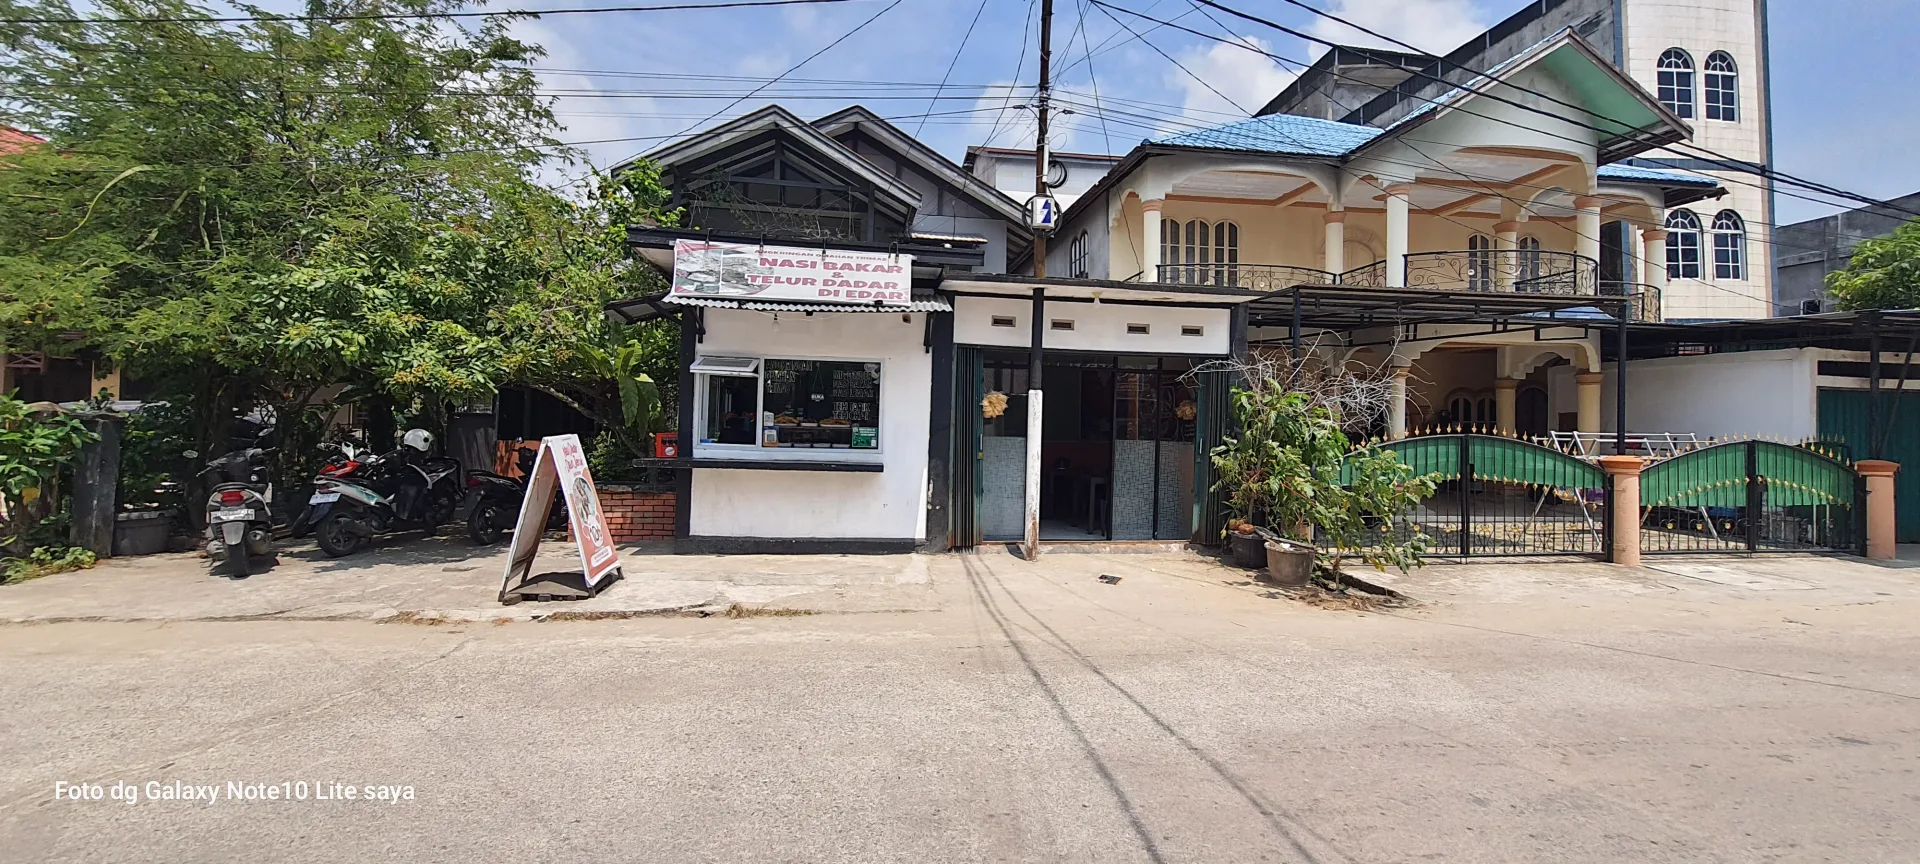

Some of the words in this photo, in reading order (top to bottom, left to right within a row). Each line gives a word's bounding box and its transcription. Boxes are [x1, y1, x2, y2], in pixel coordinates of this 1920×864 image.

[759, 258, 818, 269] NASI
[822, 261, 904, 274] BAKAR
[830, 271, 845, 279] &
[747, 275, 817, 286] TELUR
[822, 278, 899, 290] DADAR
[818, 288, 840, 298] DI
[845, 289, 904, 300] EDAR
